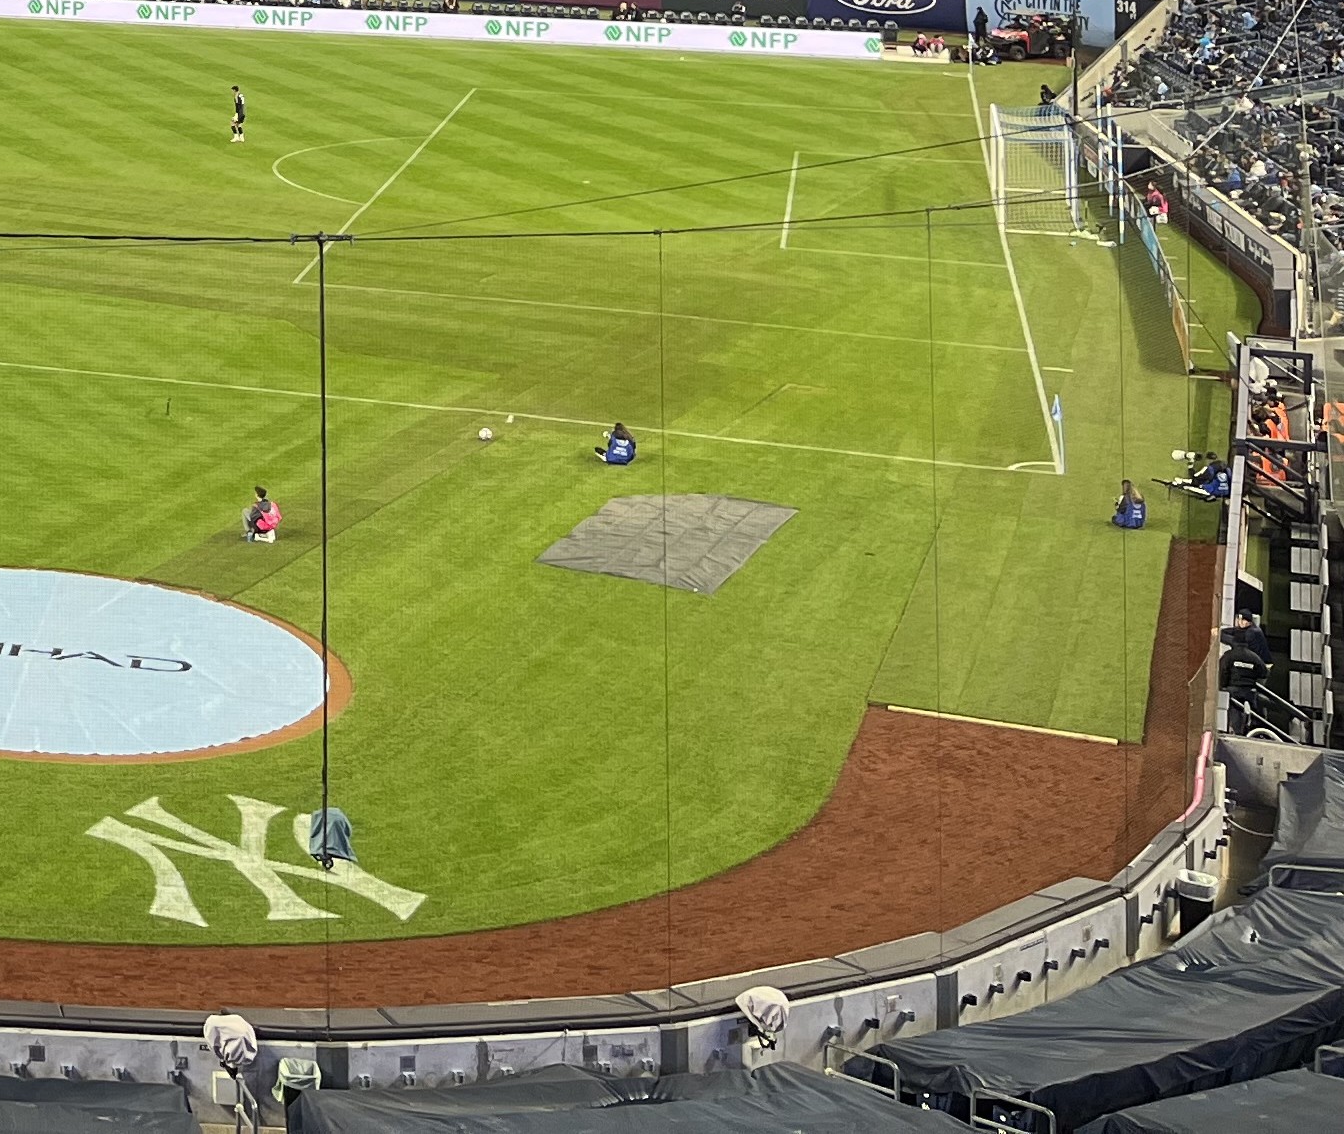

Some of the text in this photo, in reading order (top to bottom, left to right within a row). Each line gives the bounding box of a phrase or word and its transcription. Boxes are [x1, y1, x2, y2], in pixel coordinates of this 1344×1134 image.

[1117, 0, 1136, 13] 314
[272, 10, 312, 26] NFP
[751, 32, 798, 49] NFP
